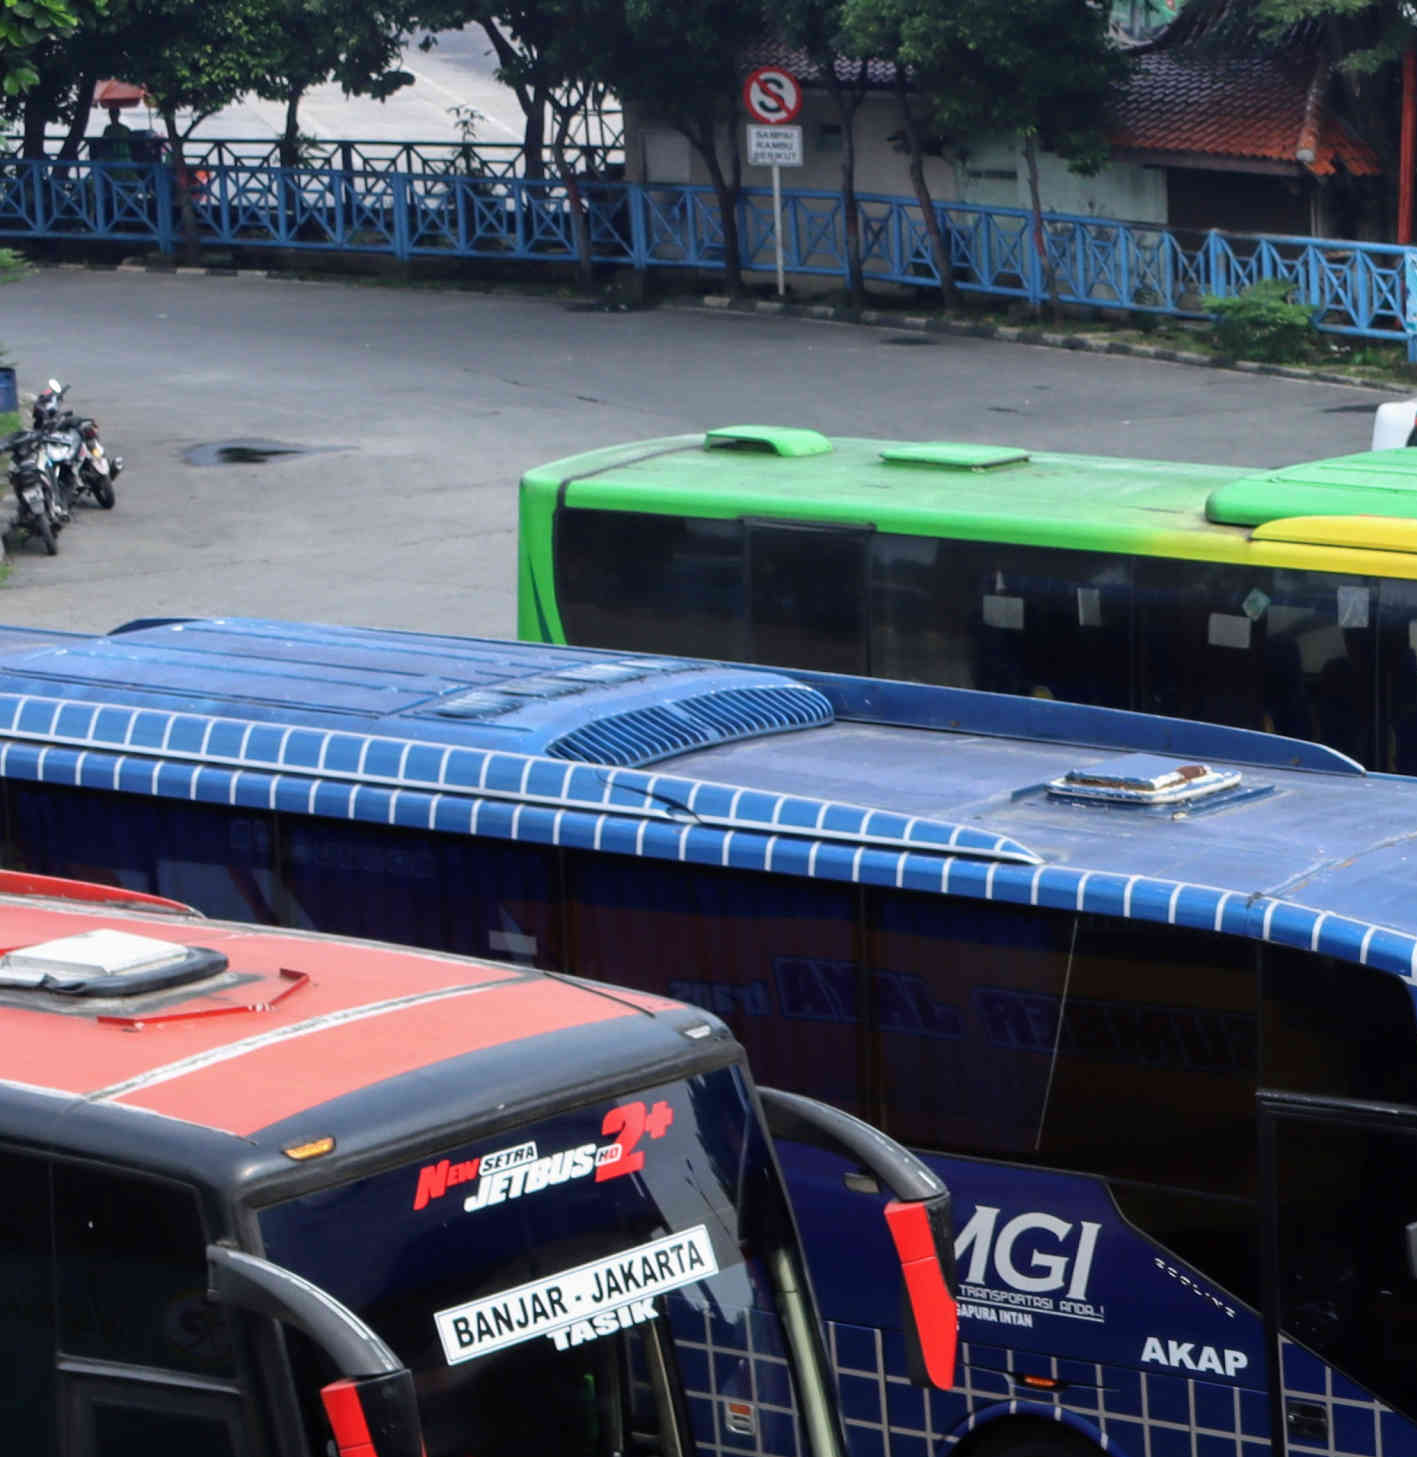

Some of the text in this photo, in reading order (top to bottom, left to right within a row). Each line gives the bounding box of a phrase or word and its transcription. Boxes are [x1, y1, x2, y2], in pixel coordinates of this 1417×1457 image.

[464, 1143, 597, 1213] JETBUS
[481, 1142, 537, 1174] SETRA
[452, 1285, 568, 1349] BANJAR
[592, 1240, 705, 1304] JAKARTA
[999, 1309, 1034, 1329] INTAN
[545, 1296, 660, 1352] TASIK
[1141, 1335, 1249, 1377] AKAP
